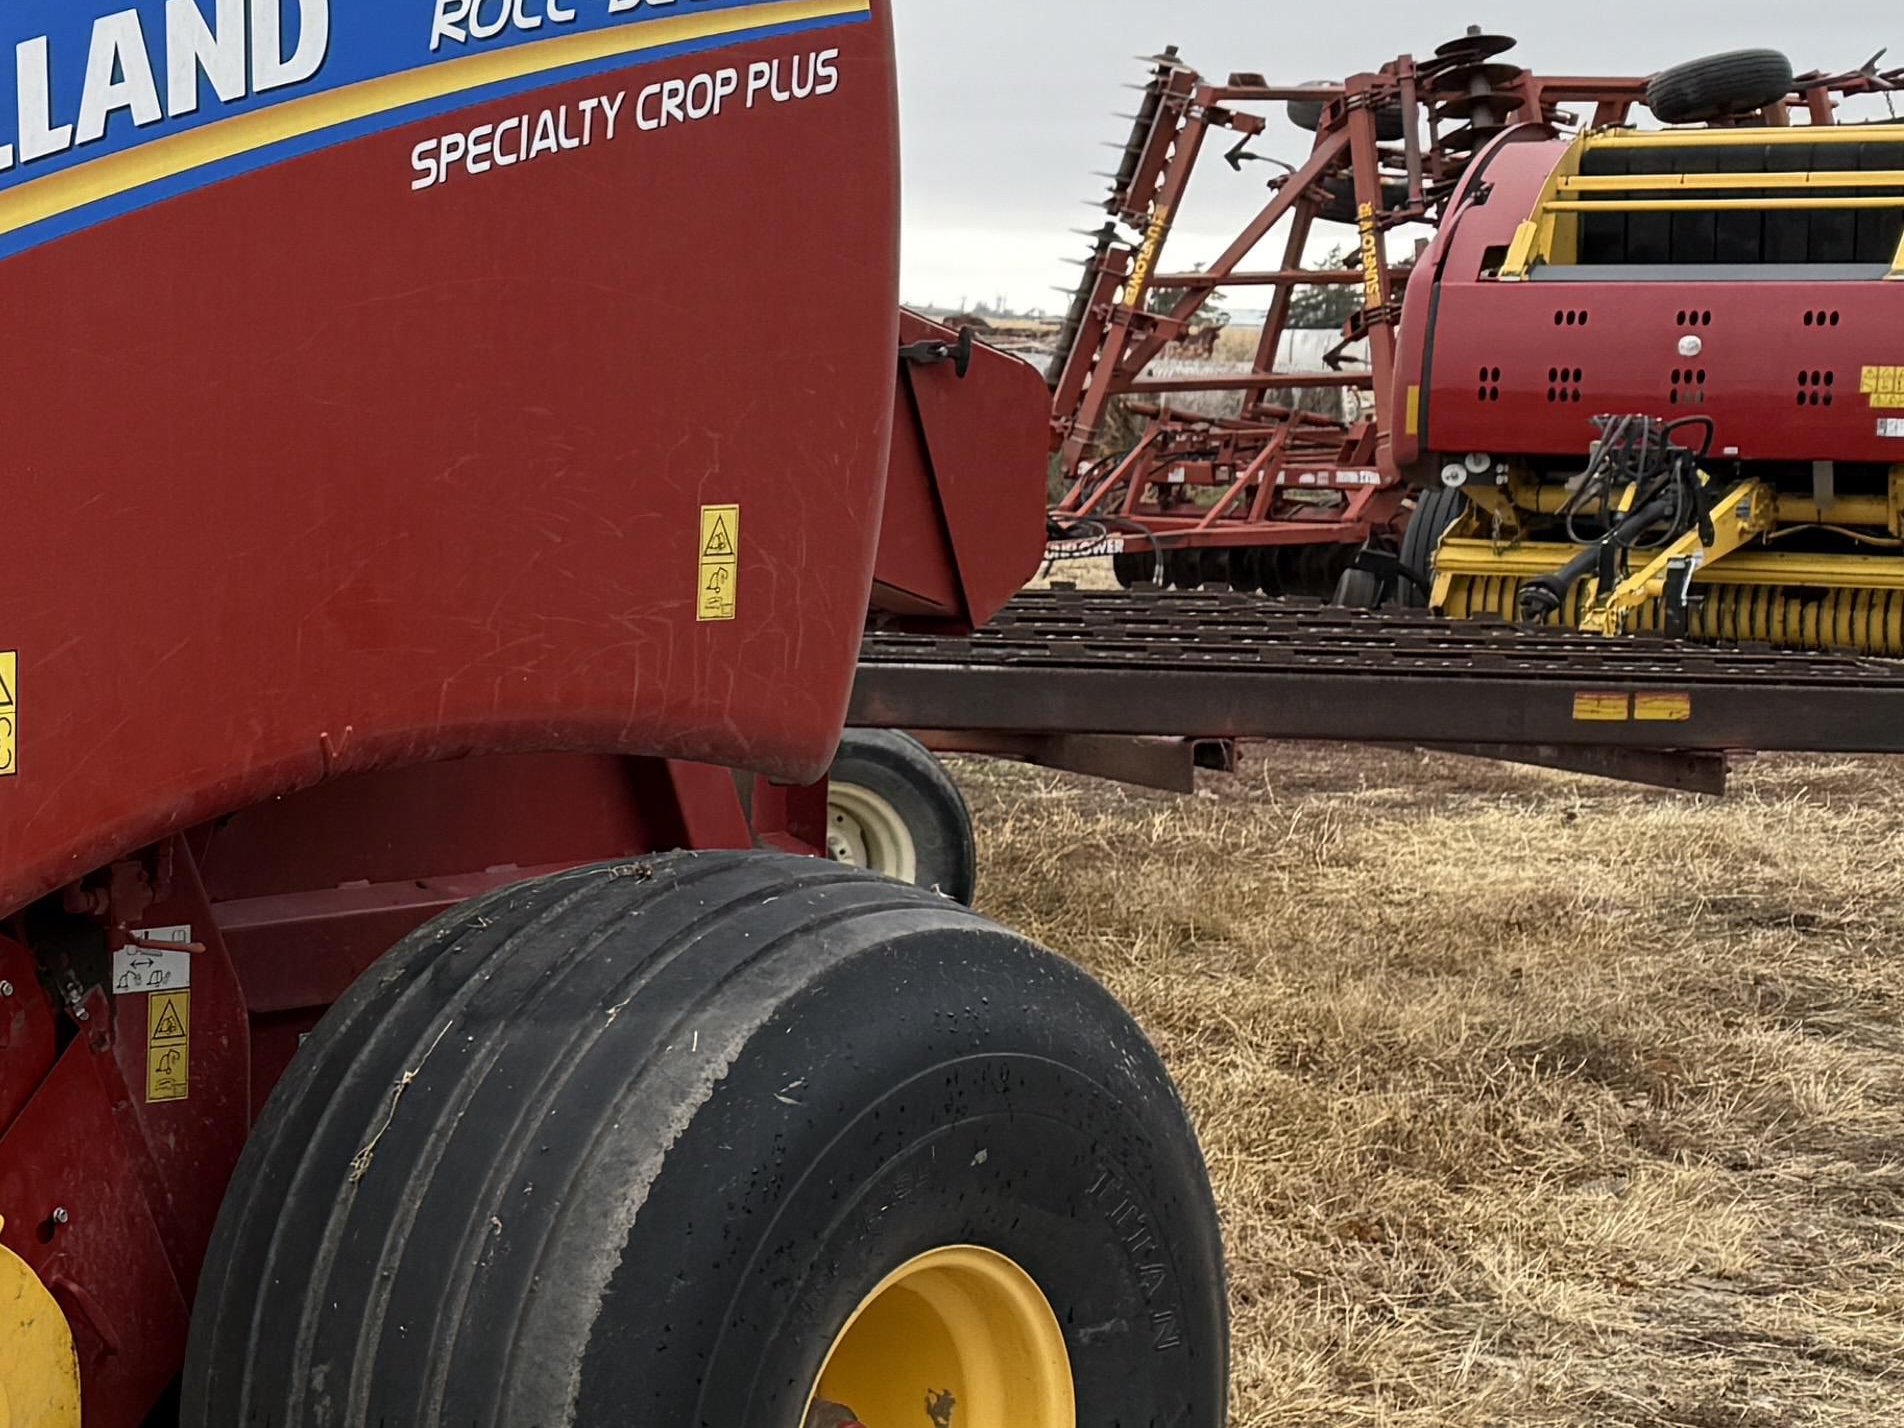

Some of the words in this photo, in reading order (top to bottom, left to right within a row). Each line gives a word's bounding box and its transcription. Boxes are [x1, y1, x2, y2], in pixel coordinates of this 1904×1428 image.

[410, 90, 626, 192] SPECIALTY
[635, 67, 739, 132] CROP
[746, 48, 840, 109] PLUS
[1085, 1161, 1182, 1352] TITAN
